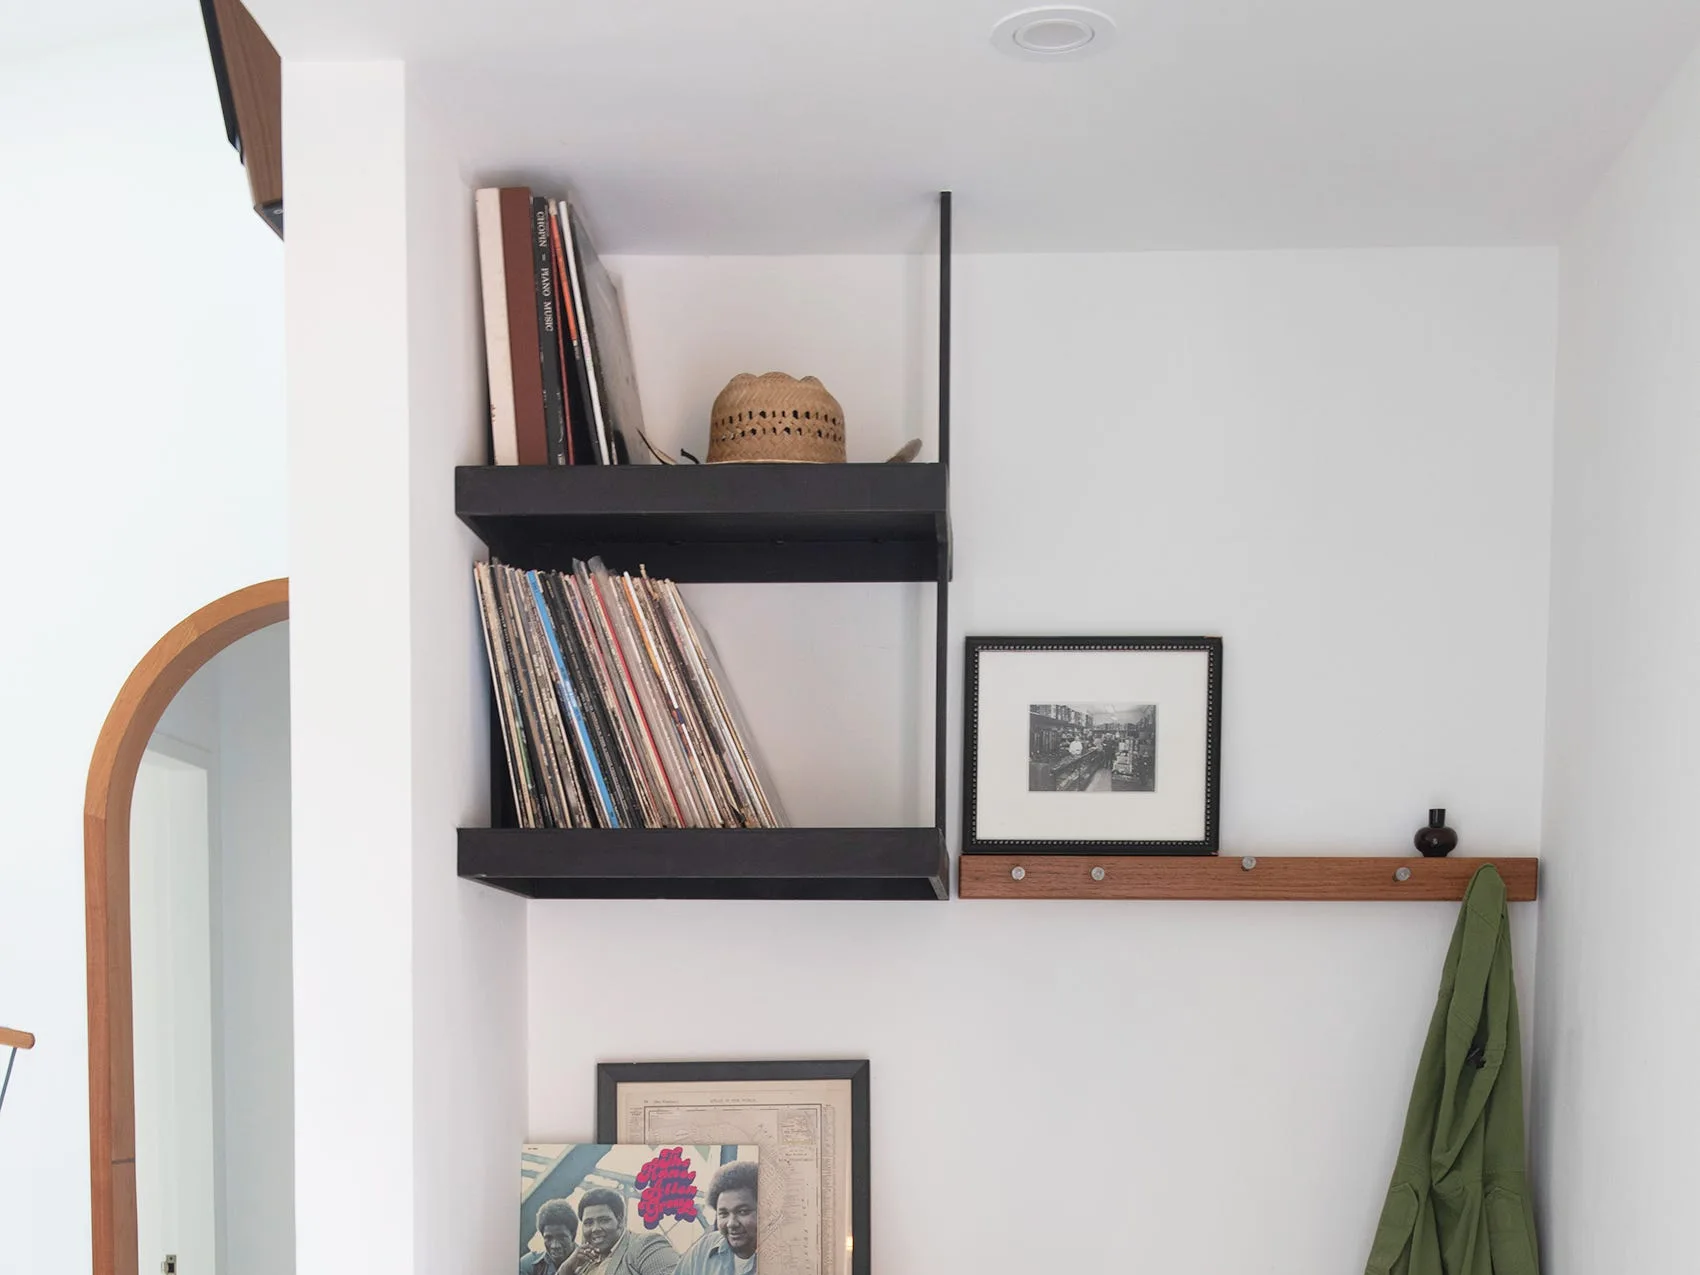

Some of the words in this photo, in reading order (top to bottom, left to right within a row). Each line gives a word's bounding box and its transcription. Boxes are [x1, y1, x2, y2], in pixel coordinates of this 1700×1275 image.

[536, 211, 547, 247] CHOPIN
[540, 267, 551, 297] PIANO
[543, 302, 554, 332] MUSIC
[641, 1179, 698, 1200] Allen
[638, 1197, 698, 1226] Group
